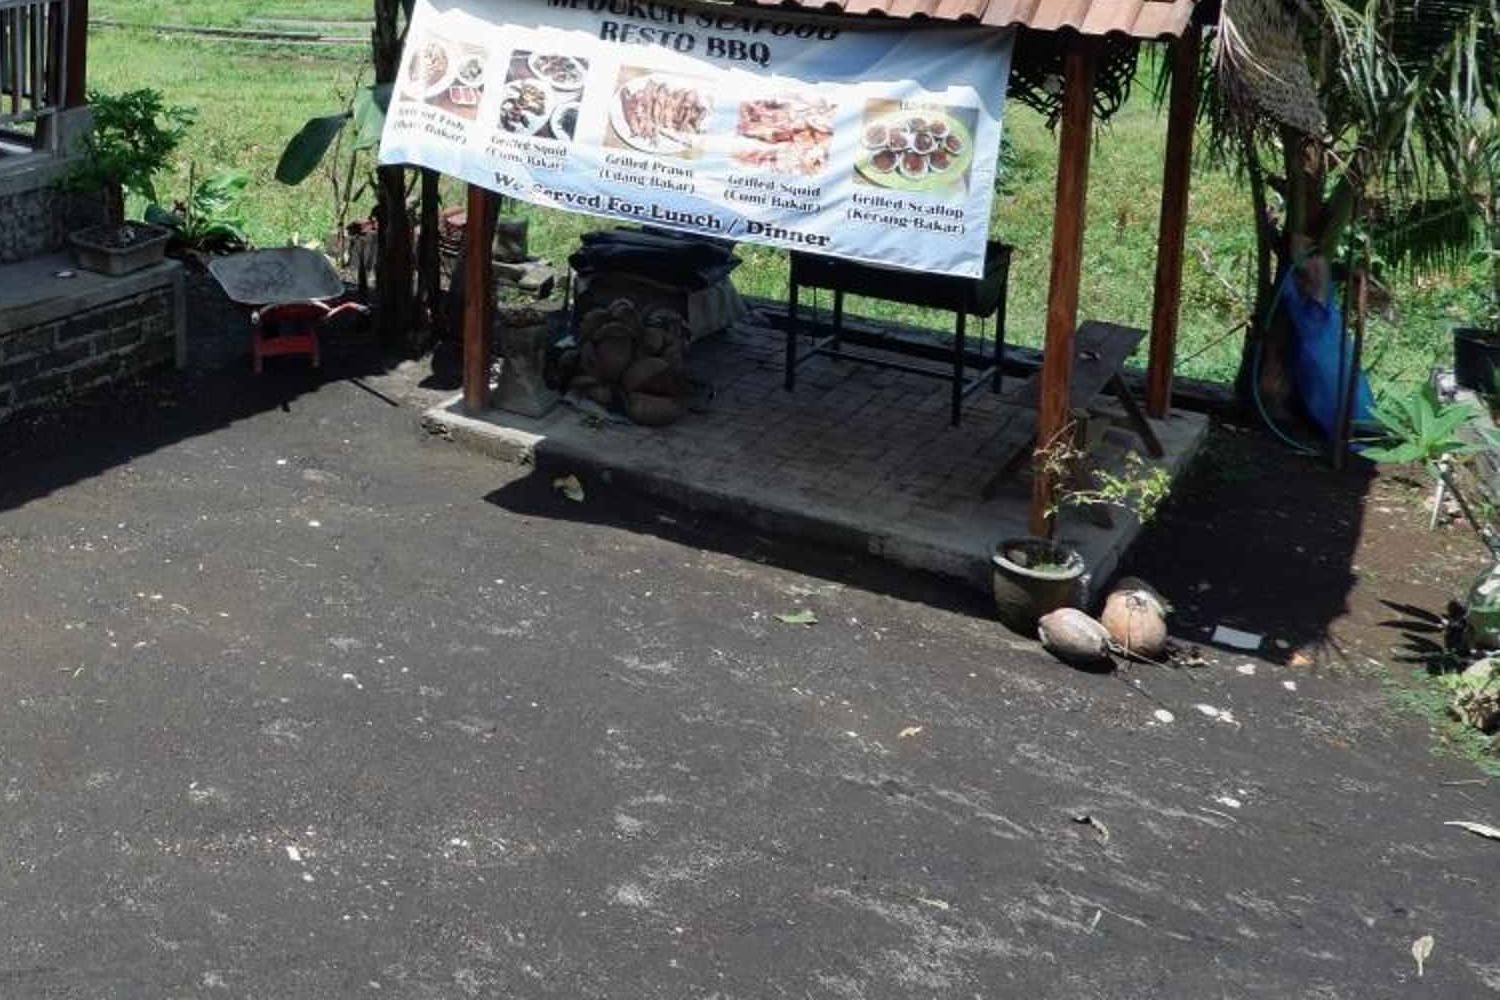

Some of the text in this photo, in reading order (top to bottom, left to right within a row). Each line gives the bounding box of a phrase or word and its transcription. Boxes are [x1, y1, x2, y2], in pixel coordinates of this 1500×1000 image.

[600, 21, 773, 68] RESTO BBQ
[425, 123, 467, 144] Bakar)
[491, 135, 568, 157] Grilled Squid
[526, 155, 566, 173] Bakar)
[605, 153, 694, 179] Grilled Prawn
[649, 175, 696, 195] Bakar)
[728, 174, 822, 200] Grilled Squid
[723, 187, 823, 215] (Cumi Bakar)
[852, 193, 965, 219] Grilled Scallop
[531, 182, 601, 210] Served
[607, 196, 645, 216] For
[651, 204, 722, 230] Lunch
[746, 219, 831, 248] Dinner
[912, 216, 966, 235] Bakar)
